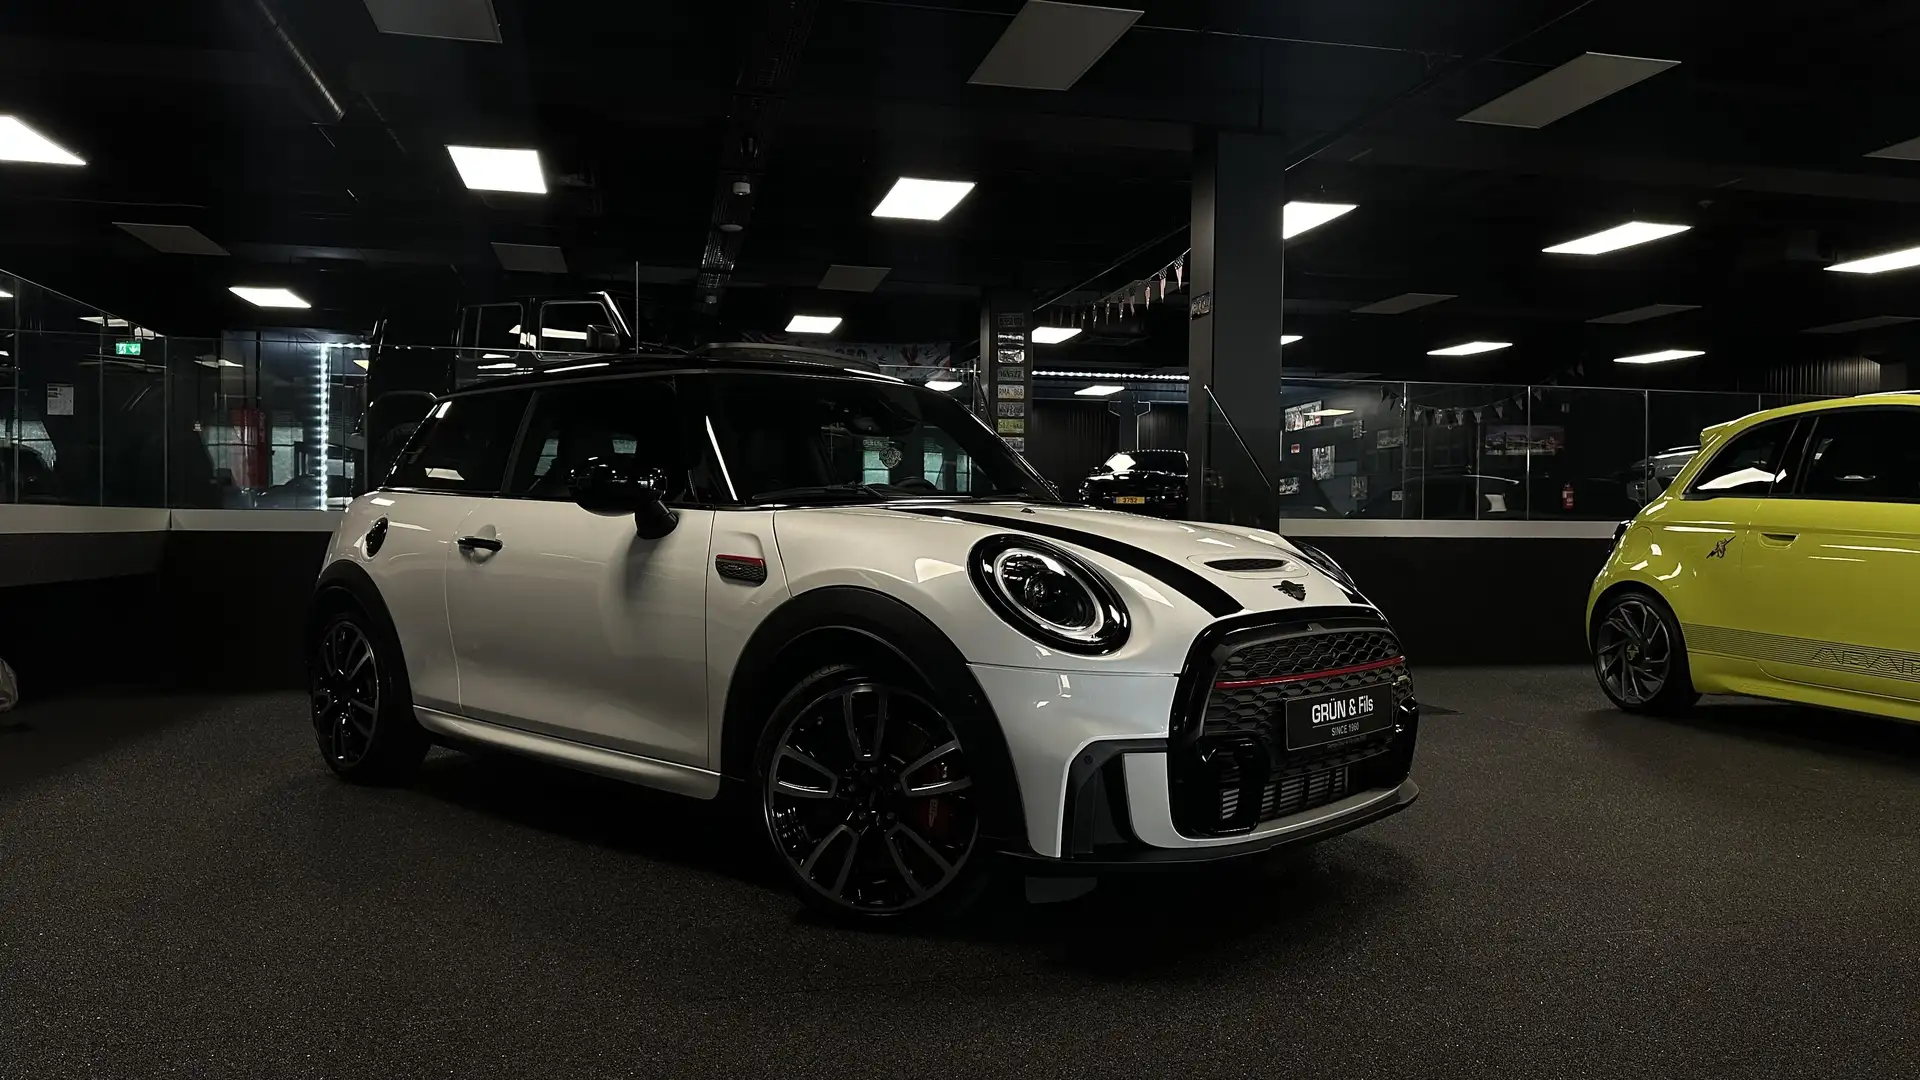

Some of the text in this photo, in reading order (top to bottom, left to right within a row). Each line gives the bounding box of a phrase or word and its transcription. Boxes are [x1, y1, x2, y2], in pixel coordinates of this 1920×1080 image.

[1312, 695, 1374, 723] GRÜN & Fils
[1331, 724, 1348, 737] SINCE
